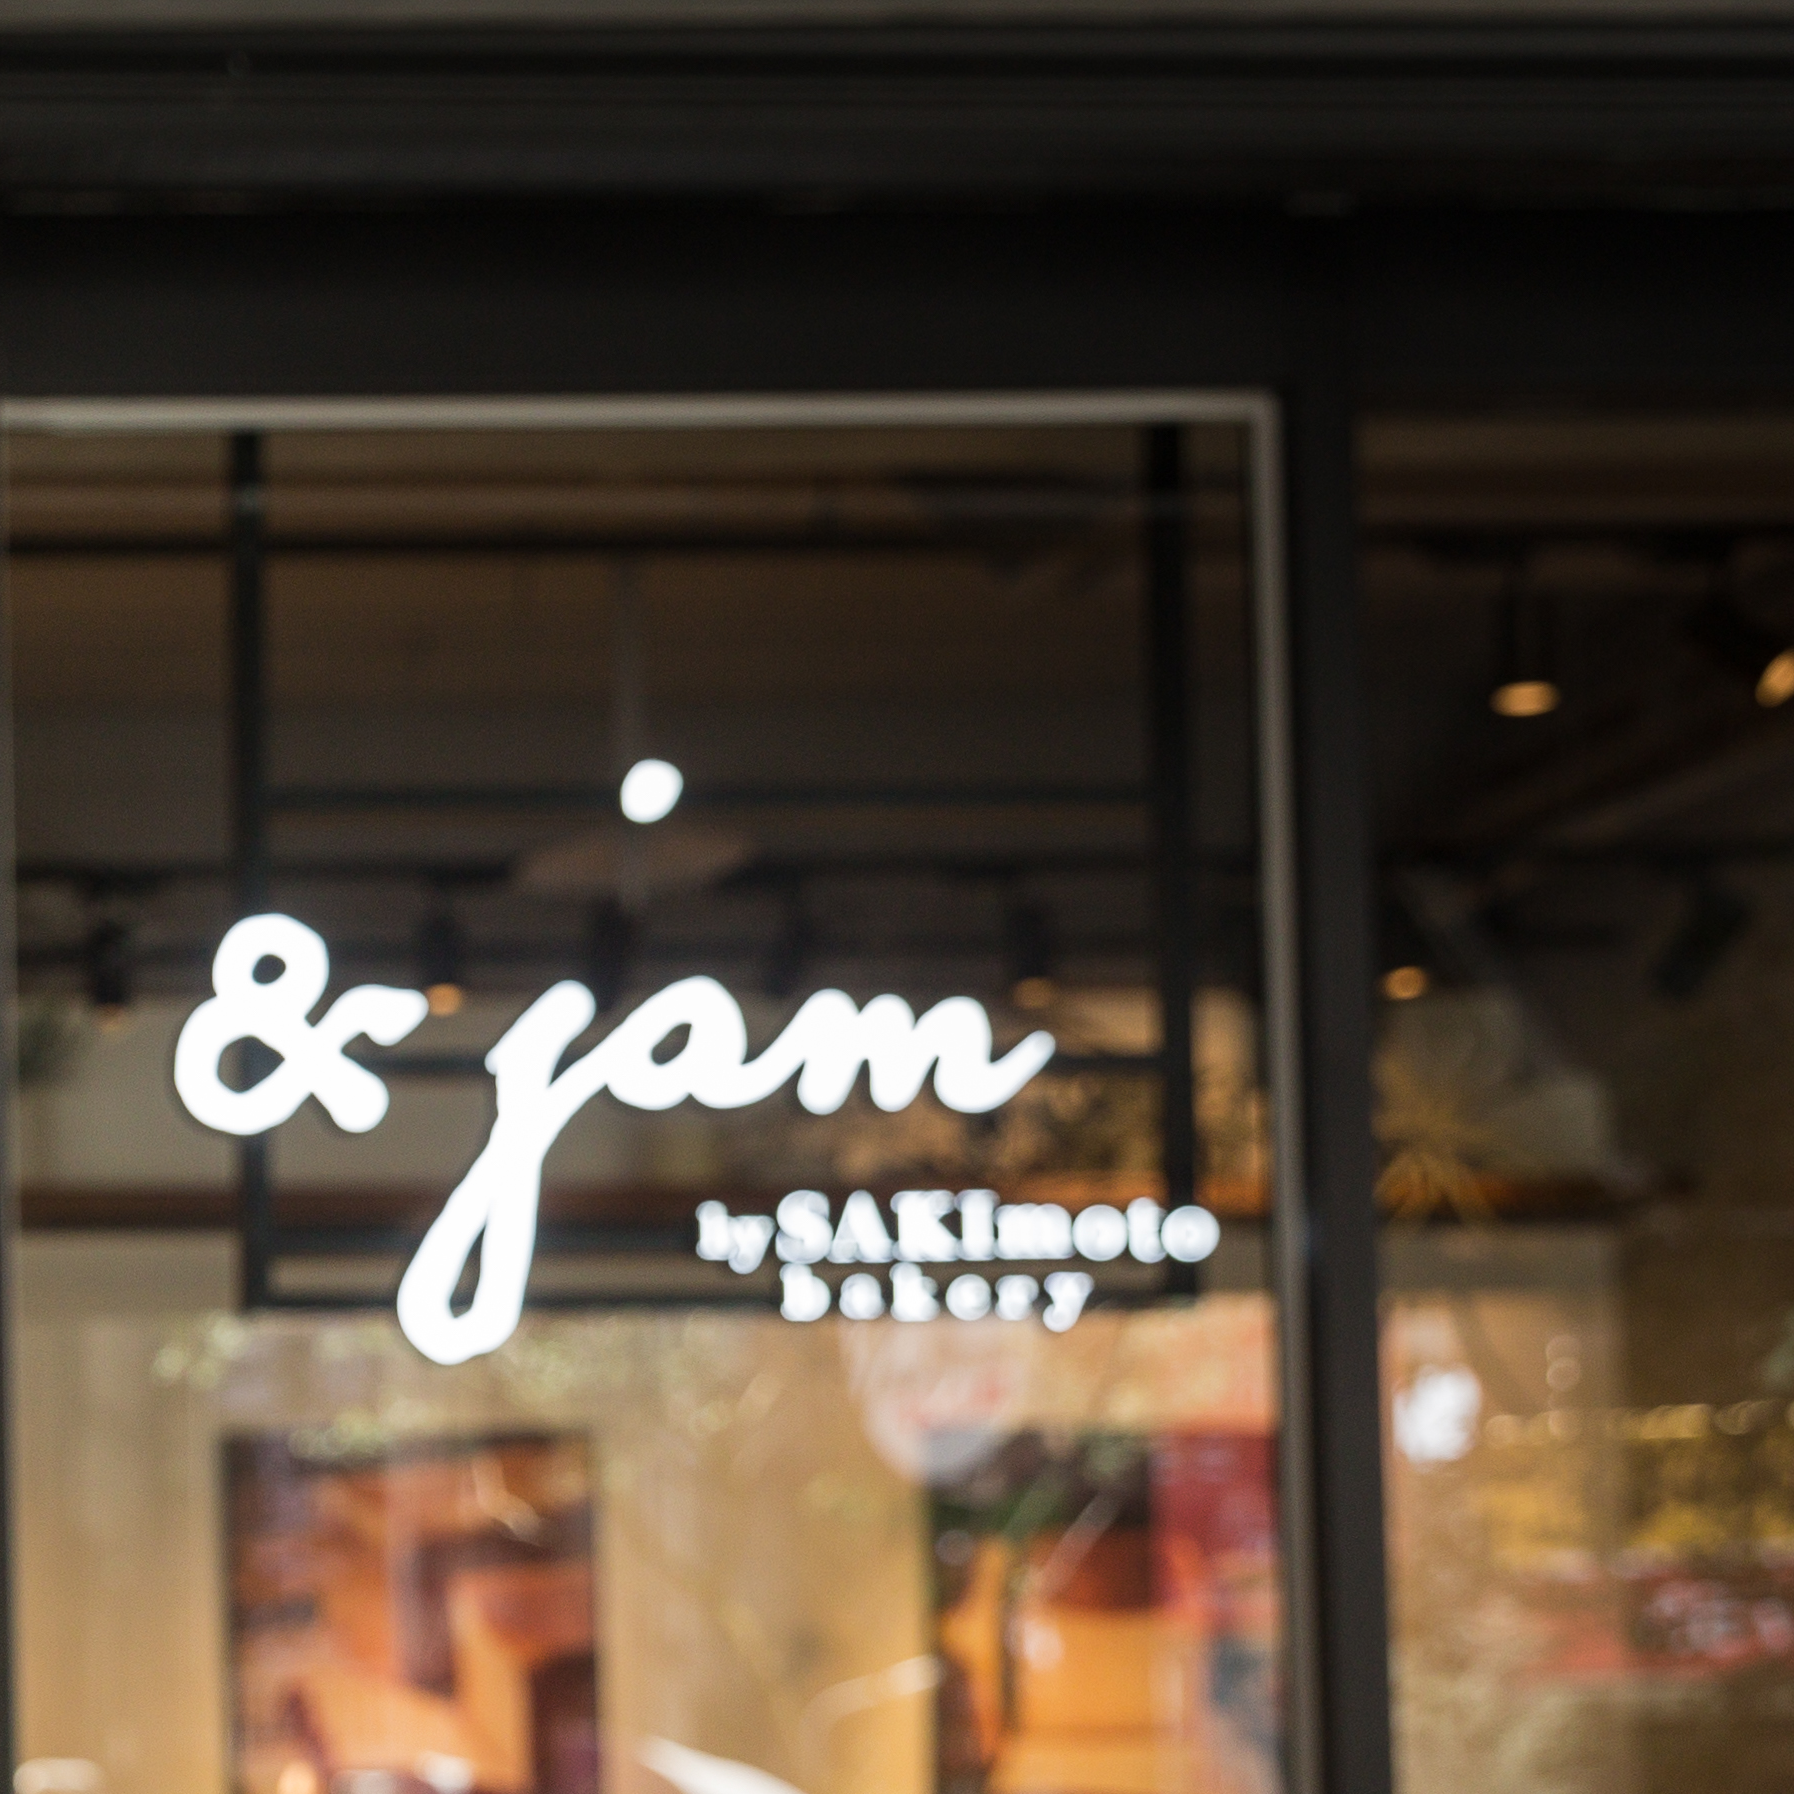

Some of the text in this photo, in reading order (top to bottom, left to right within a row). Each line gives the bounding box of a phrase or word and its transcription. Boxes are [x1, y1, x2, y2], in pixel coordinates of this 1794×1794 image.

[174, 758, 1056, 1366] & jam
[696, 1189, 1221, 1274] by SAKImoto
[779, 1262, 1094, 1333] bakery
